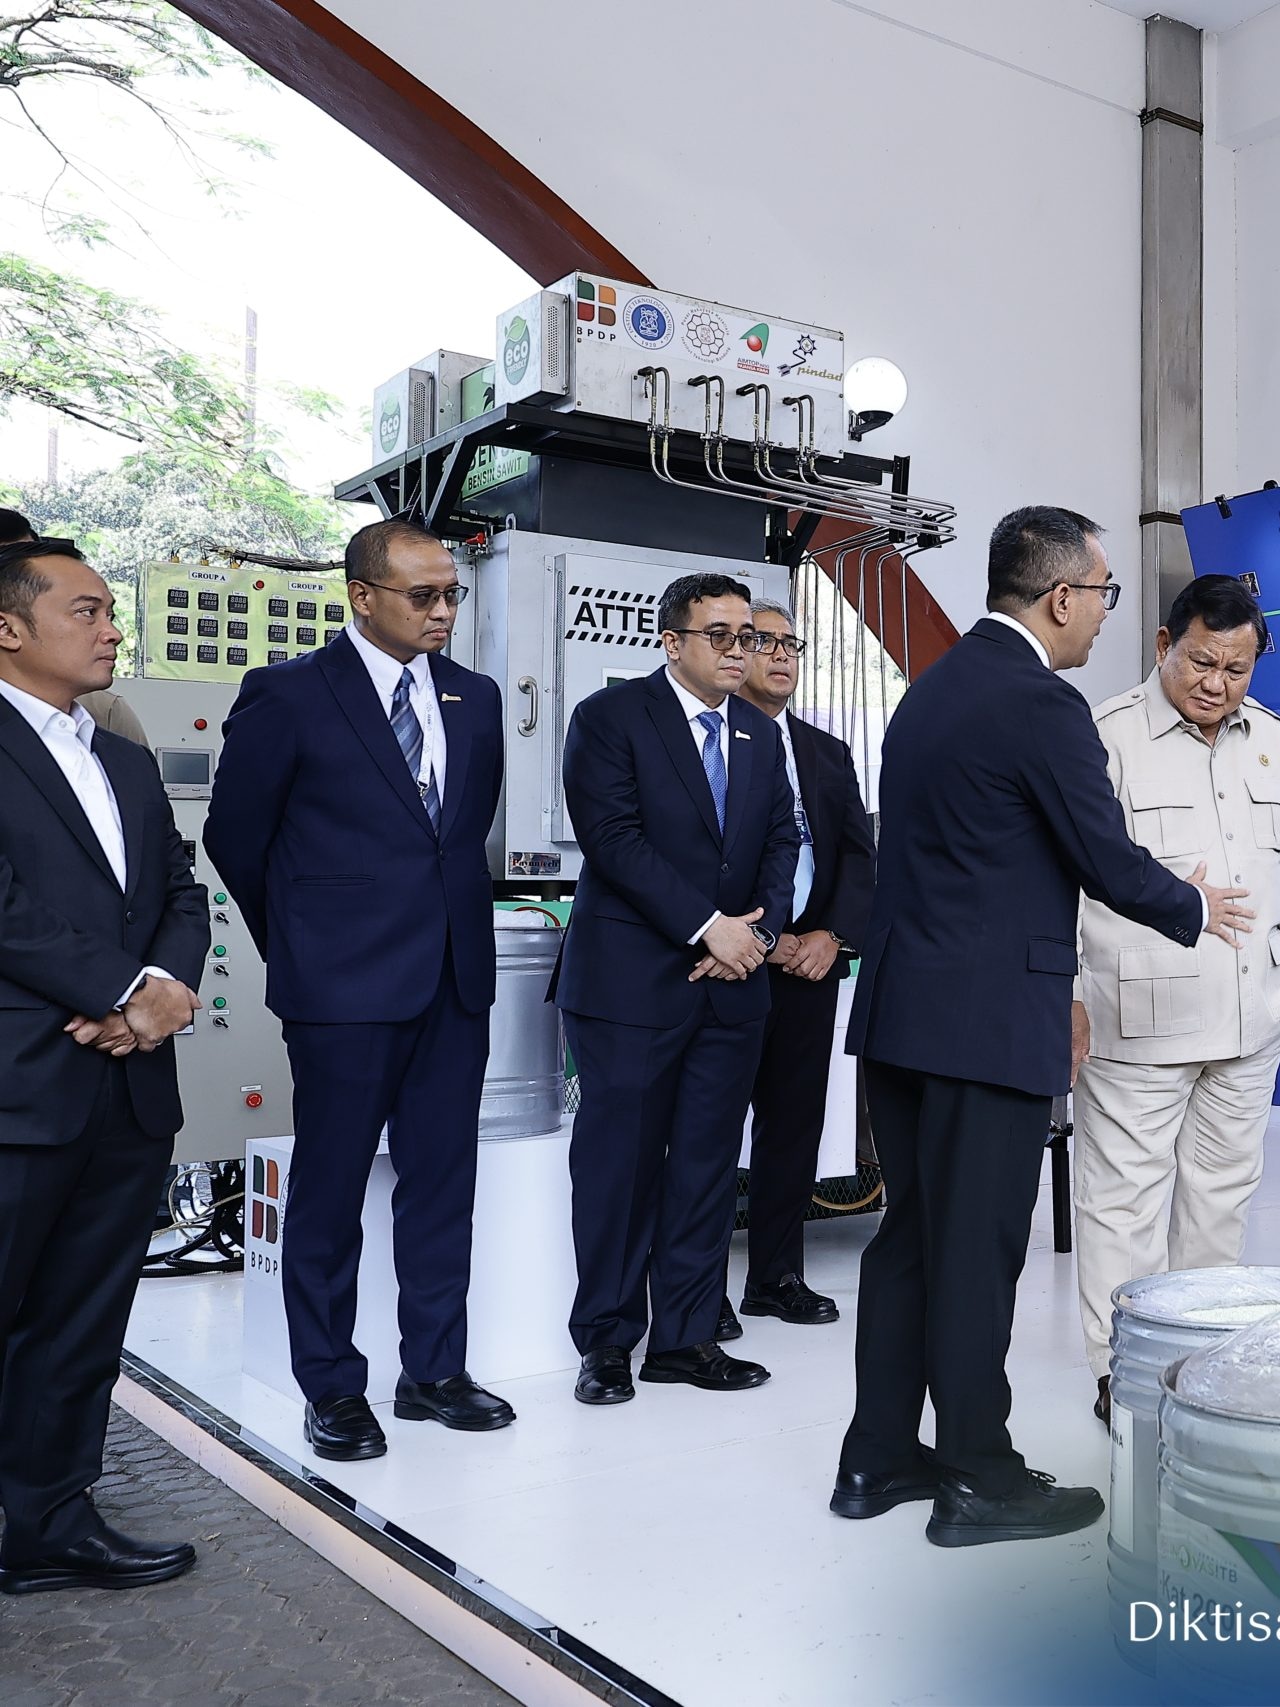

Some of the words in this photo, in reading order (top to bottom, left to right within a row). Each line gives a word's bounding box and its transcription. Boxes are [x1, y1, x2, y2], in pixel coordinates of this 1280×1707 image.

[505, 341, 529, 362] eco
[797, 366, 843, 381] pindad
[381, 415, 399, 435] eco
[468, 468, 495, 490] BENSIN
[496, 457, 521, 478] SAWIT
[191, 571, 217, 581] GROUP
[219, 574, 227, 582] A
[291, 582, 317, 591] GROUP
[318, 584, 325, 592] B
[573, 601, 661, 635] ATTE
[251, 1251, 279, 1277] BPDP
